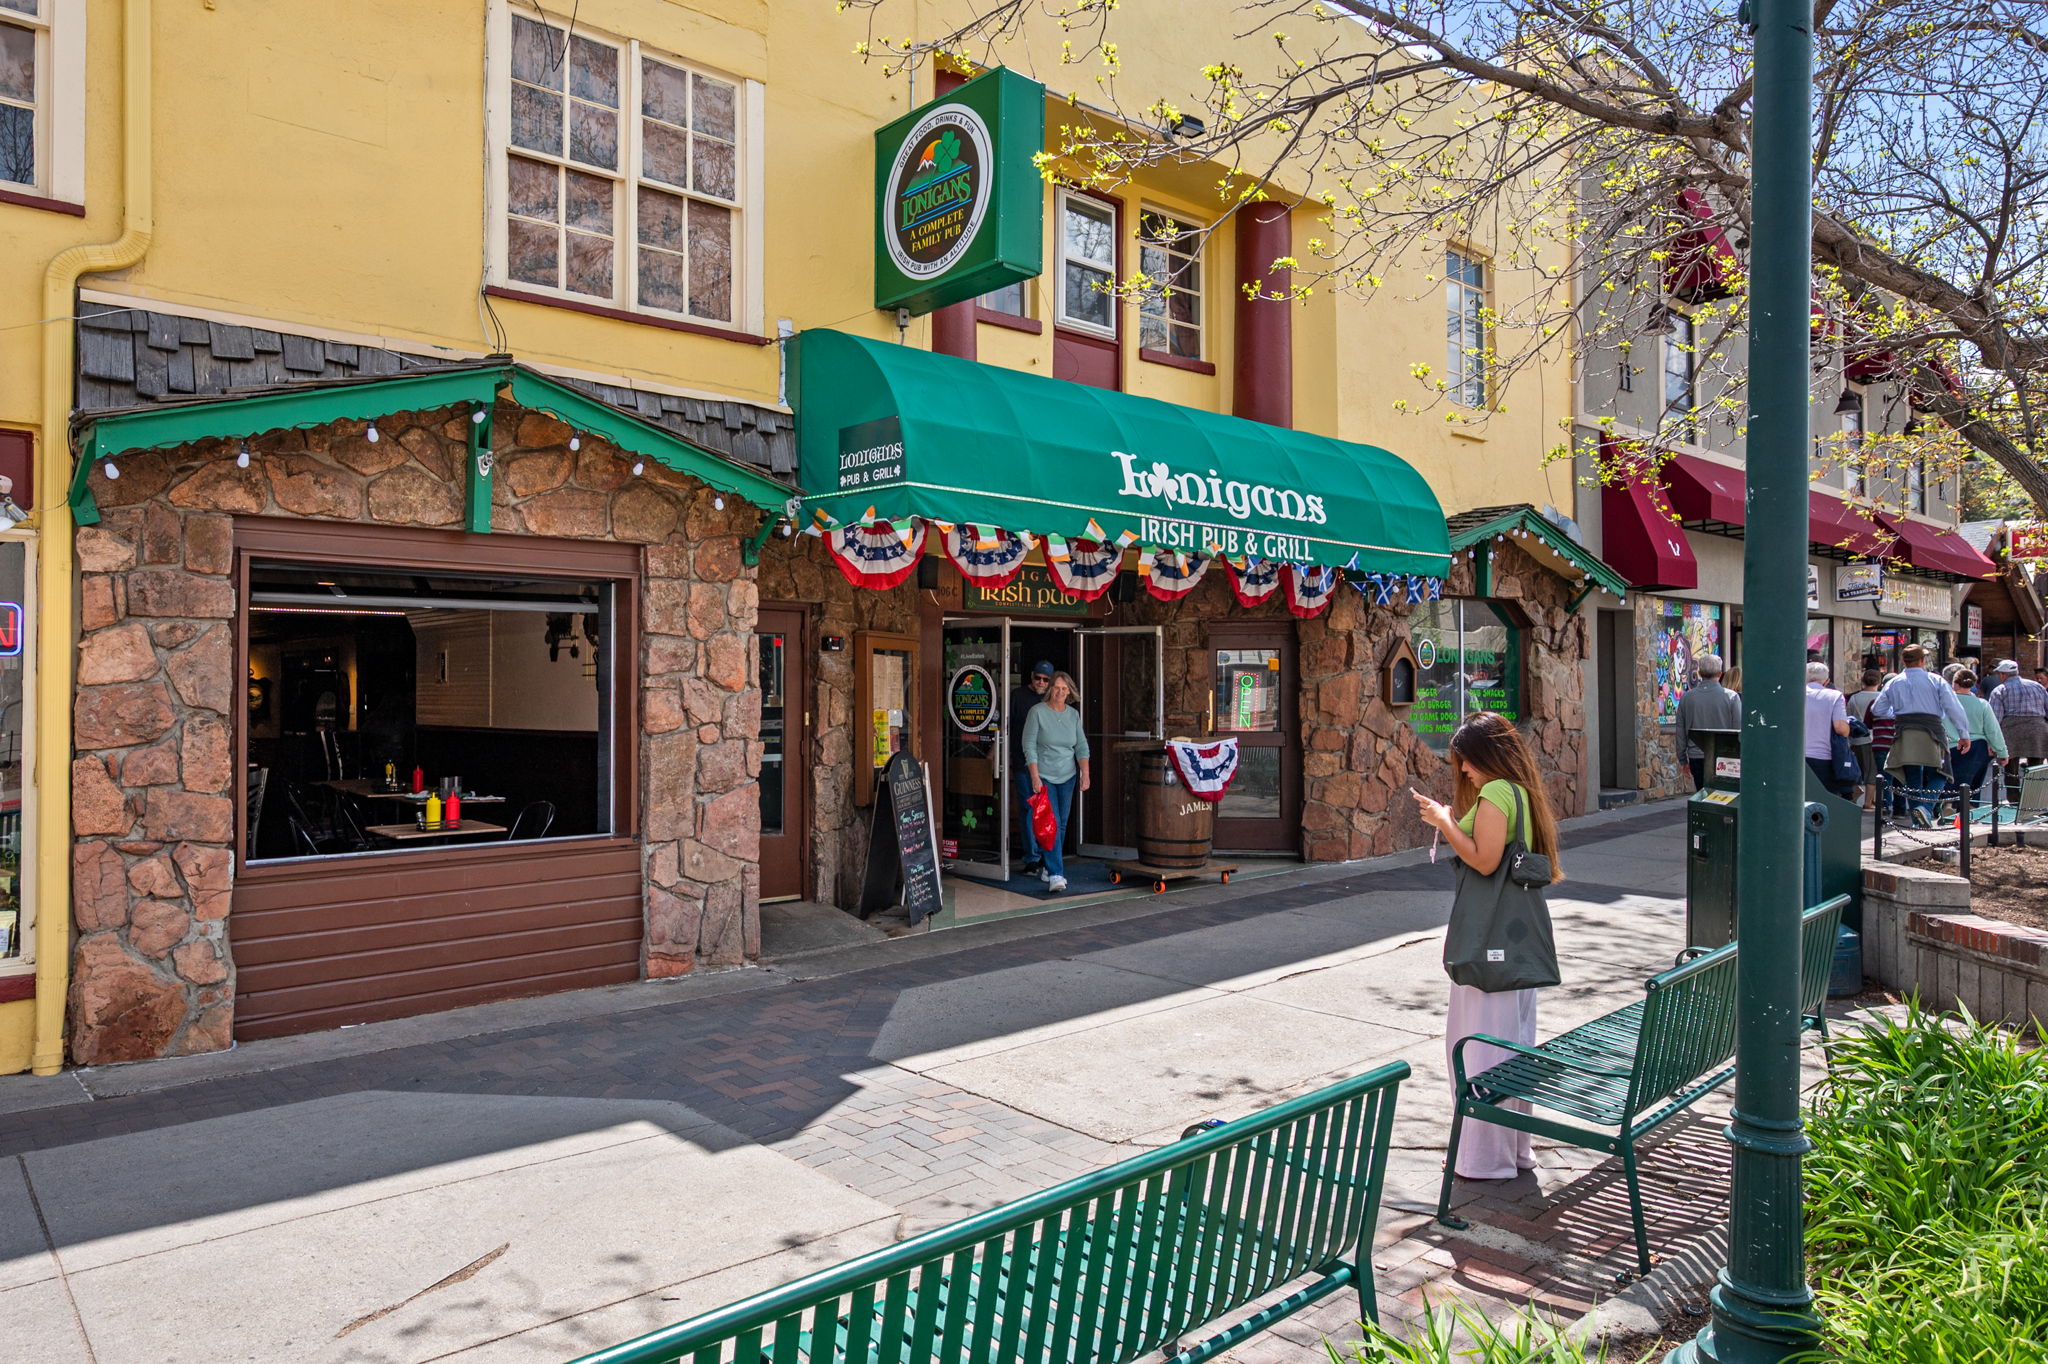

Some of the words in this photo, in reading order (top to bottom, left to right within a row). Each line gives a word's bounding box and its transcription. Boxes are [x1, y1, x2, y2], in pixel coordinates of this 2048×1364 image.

[899, 141, 915, 168] GREAT
[935, 114, 958, 125] DRINKS
[964, 119, 975, 135] FUN
[902, 172, 971, 228] LONIGANS
[909, 230, 916, 241] A
[918, 208, 964, 236] COMPLETE
[911, 235, 941, 253] FAMILY
[944, 224, 961, 240] PUB
[897, 249, 910, 266] IRISH
[911, 260, 922, 272] PUB
[923, 262, 938, 272] WITH
[939, 256, 949, 265] AN
[949, 221, 975, 259] ALTITUDE
[839, 442, 904, 471] LONIGANS
[846, 473, 860, 486] PUB
[863, 471, 869, 483] &
[872, 466, 894, 481] GRILL
[1110, 451, 1327, 525] Lnigans
[1140, 517, 1194, 548] IRISH
[1202, 526, 1239, 554] PUB
[1245, 532, 1258, 555] &
[1263, 535, 1314, 561] GRILL
[1916, 585, 1951, 613] TRADING
[1436, 647, 1495, 665] LONGANS
[1239, 675, 1253, 728] OPEN
[1428, 700, 1452, 710] BURGER
[1482, 689, 1505, 698] SNACKS
[1490, 700, 1508, 709] CHIPS
[1440, 712, 1458, 721] DOGS
[893, 778, 921, 796] GUINNESS
